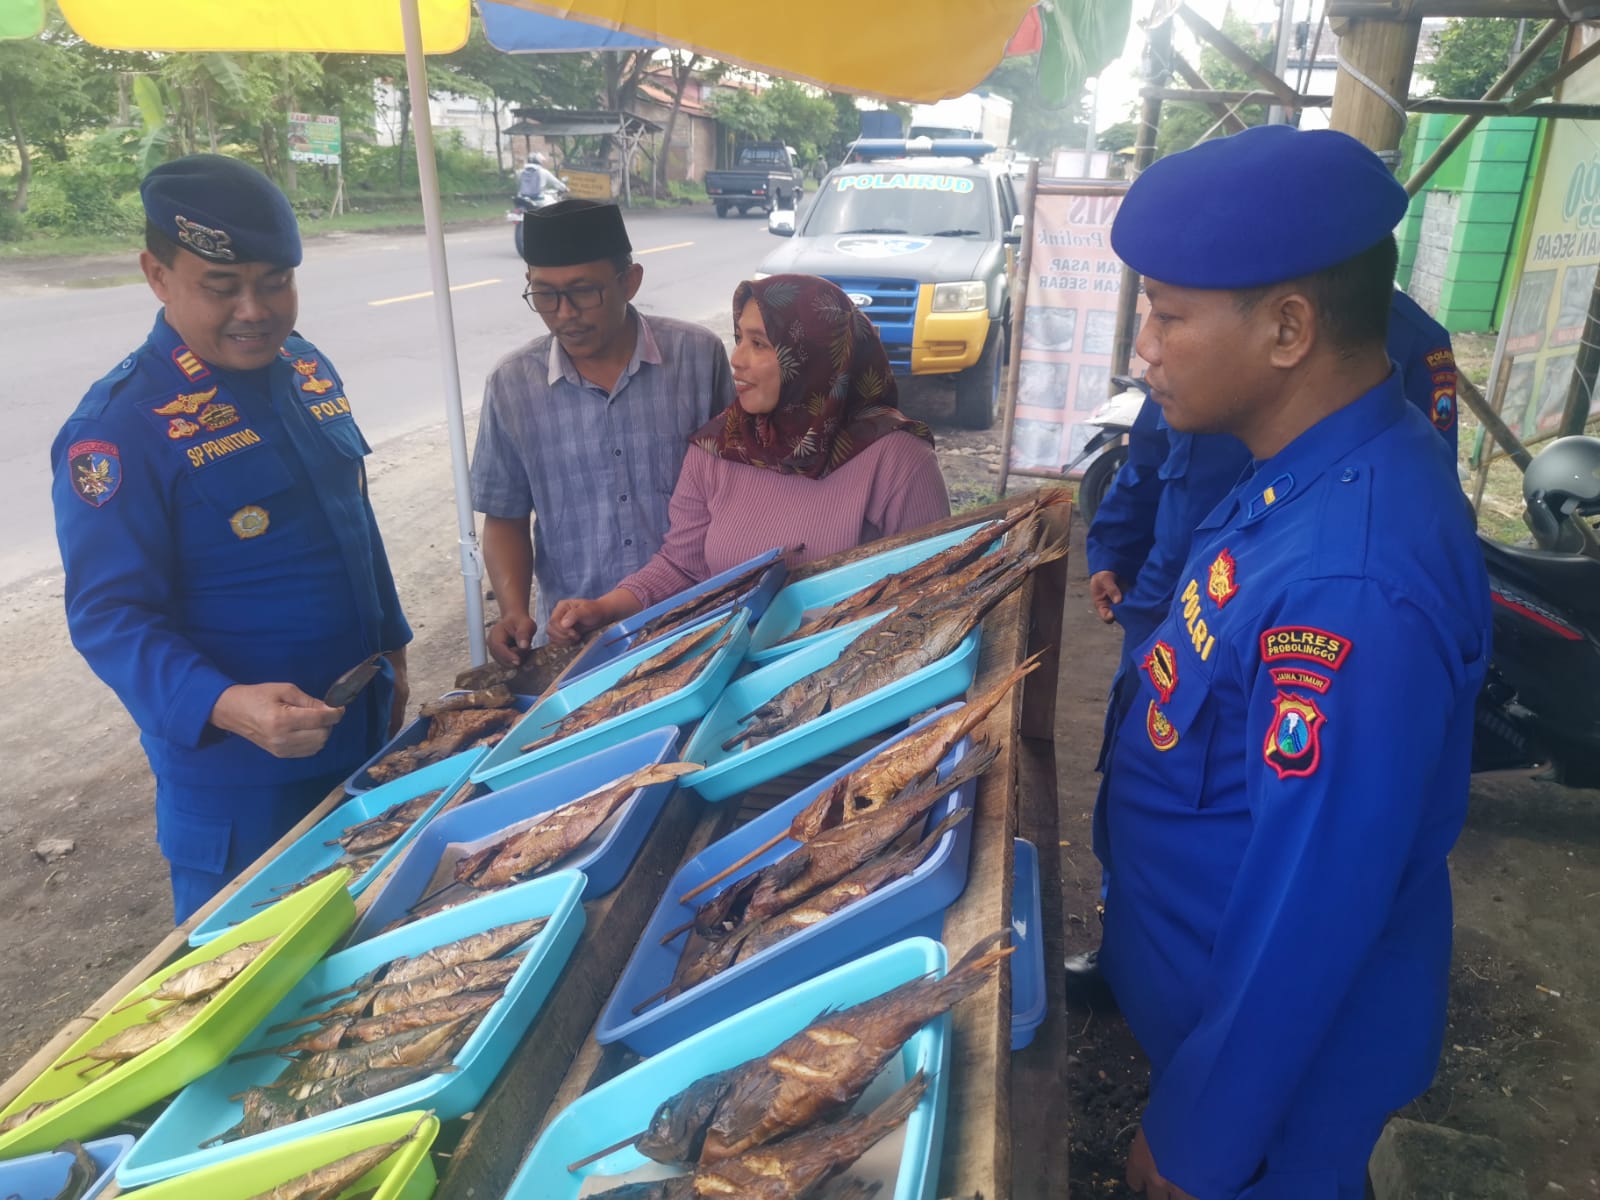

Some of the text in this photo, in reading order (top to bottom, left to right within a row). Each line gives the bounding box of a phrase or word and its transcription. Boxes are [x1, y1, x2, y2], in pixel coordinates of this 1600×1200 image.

[837, 174, 974, 194] POLAIRUD
[187, 446, 205, 467] SP
[1181, 579, 1216, 661] POLRI
[1267, 631, 1340, 651] POLRES
[1268, 643, 1336, 661] PROBOLINGGO
[1277, 672, 1324, 688] JAWA TIMUR
